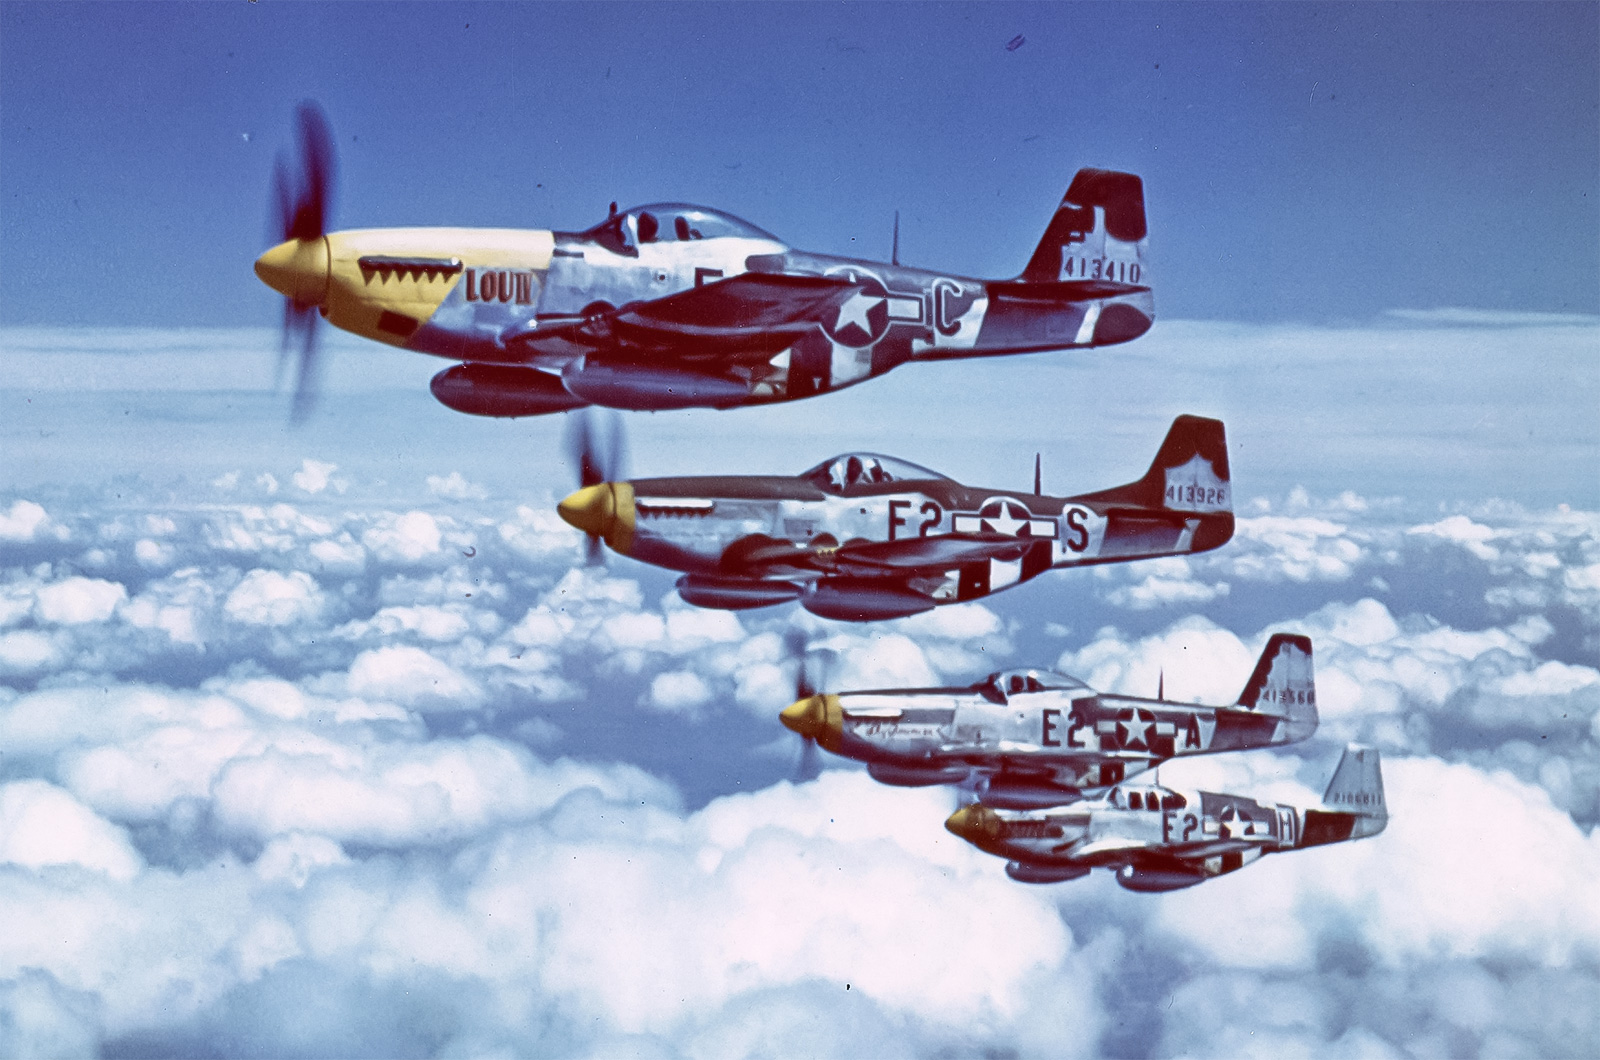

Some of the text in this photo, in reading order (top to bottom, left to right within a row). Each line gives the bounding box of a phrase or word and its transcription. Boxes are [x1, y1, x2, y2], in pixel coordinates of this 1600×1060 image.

[1063, 256, 1141, 284] 413410
[933, 279, 962, 336] C
[1166, 485, 1226, 505] 413926
[1067, 508, 1089, 552] S
[1042, 709, 1086, 748] E2
[1185, 711, 1201, 750] A
